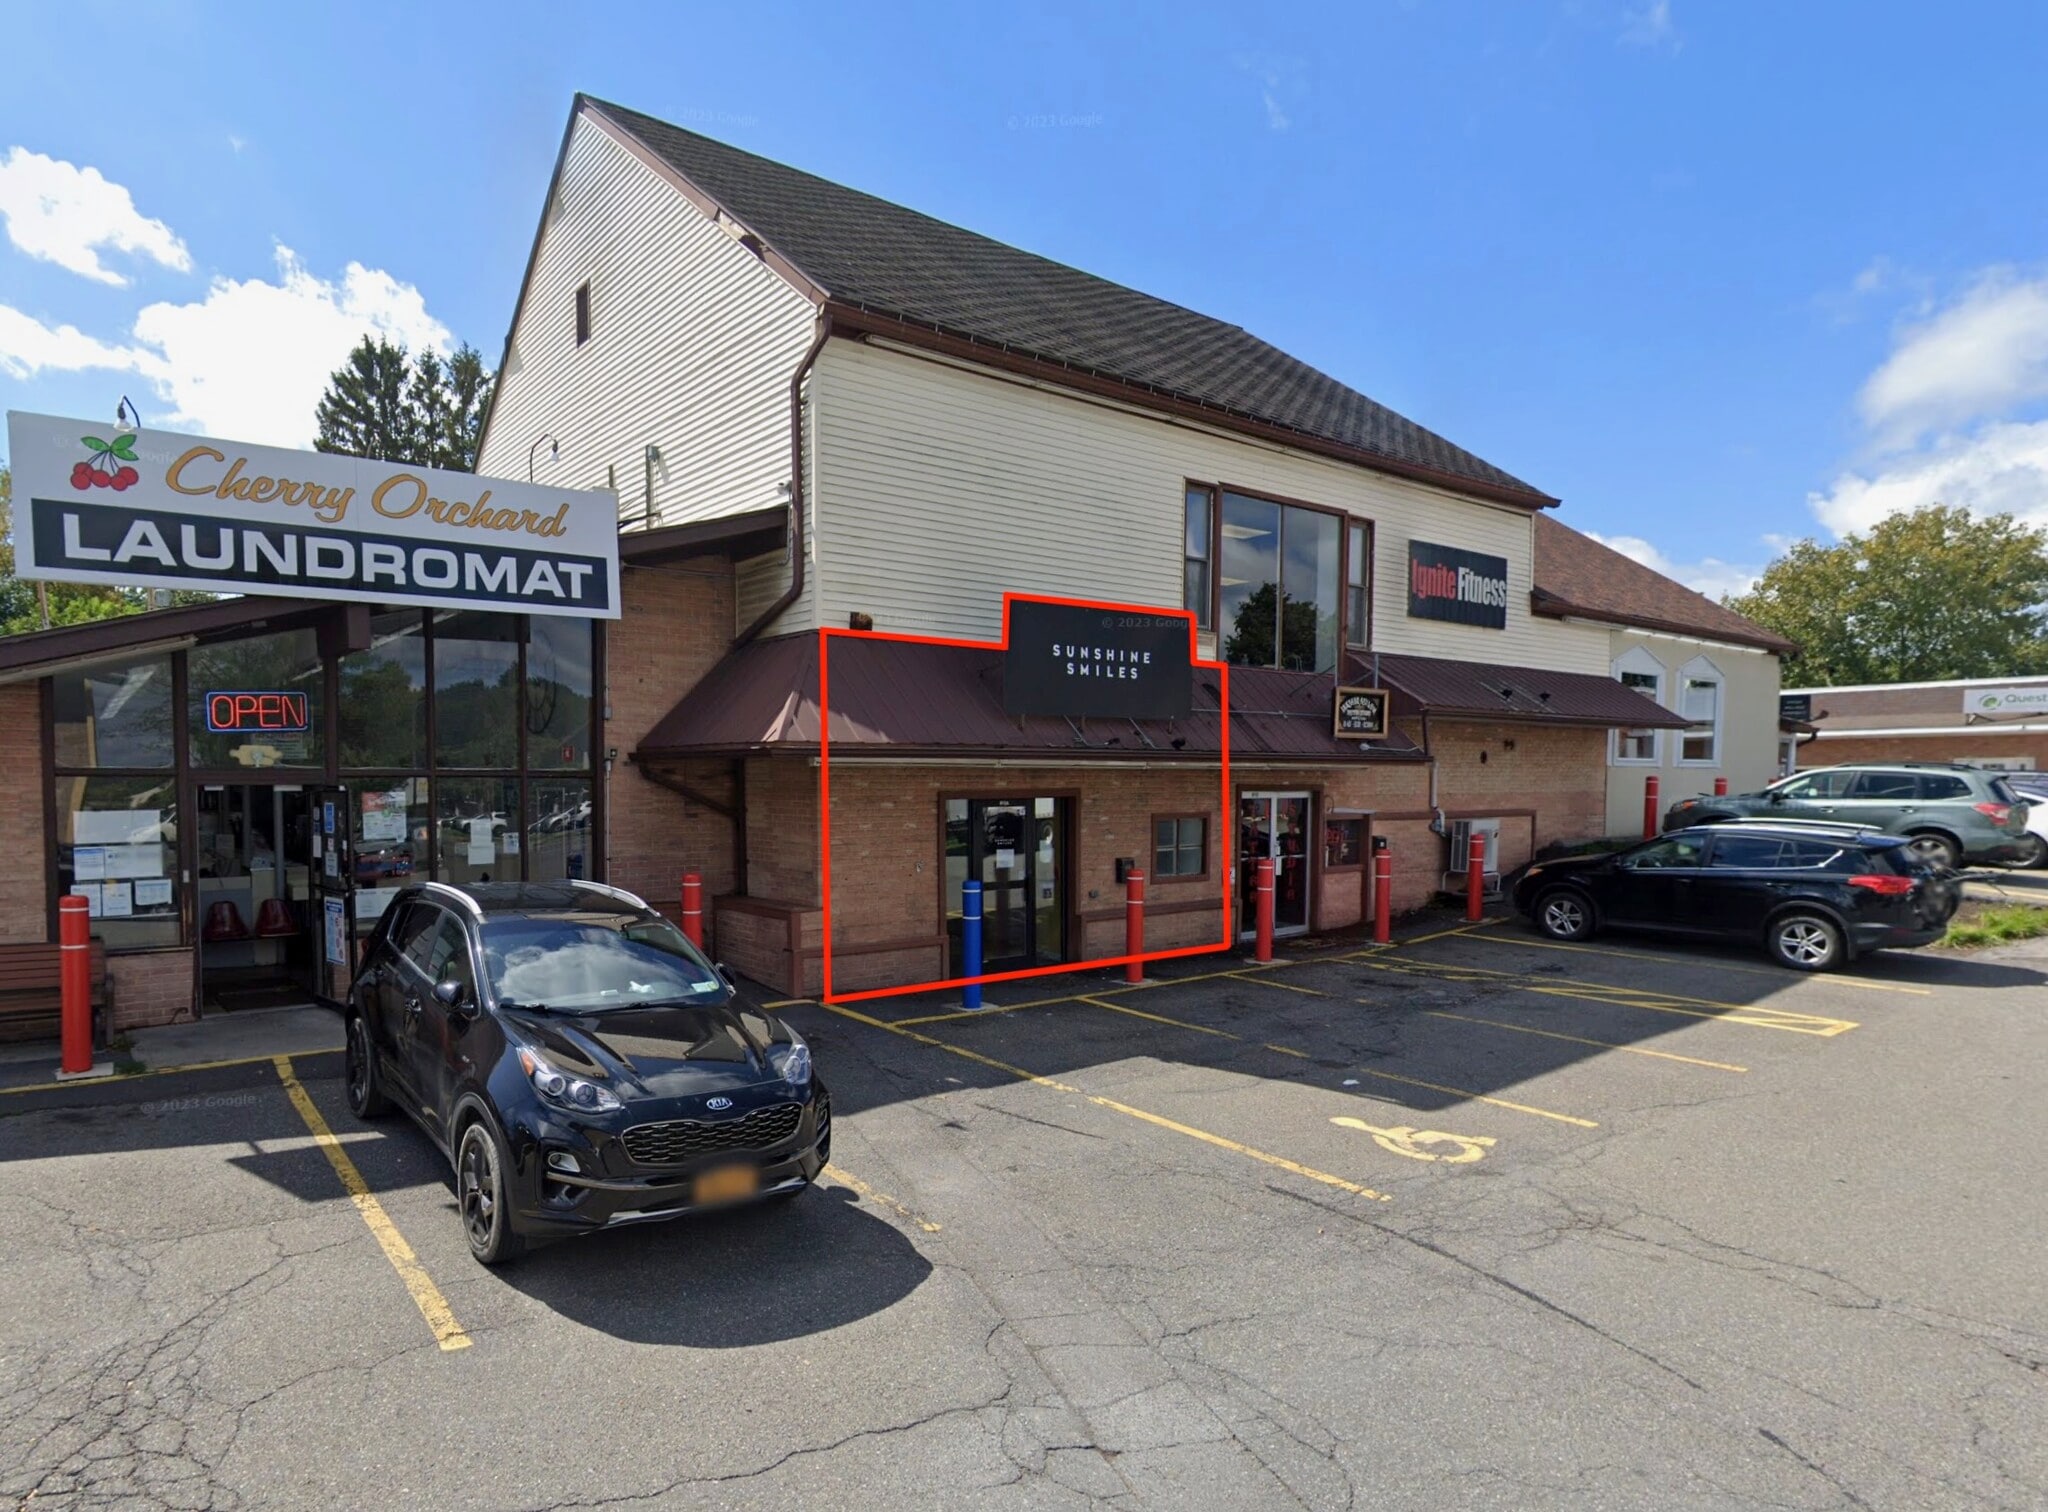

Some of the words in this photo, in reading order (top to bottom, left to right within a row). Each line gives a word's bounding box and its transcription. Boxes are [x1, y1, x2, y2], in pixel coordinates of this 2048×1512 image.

[165, 445, 355, 523] Cherry
[371, 473, 570, 538] Orchard
[62, 513, 594, 600] LAUNDROMAT
[1411, 558, 1456, 599] Ignite
[1457, 566, 1506, 608] Fitness
[1052, 644, 1150, 664] SUNSHINE
[1066, 662, 1138, 680] SMILES
[211, 695, 304, 728] OPEN
[2004, 693, 2048, 704] Quest
[709, 1098, 730, 1109] KIA
